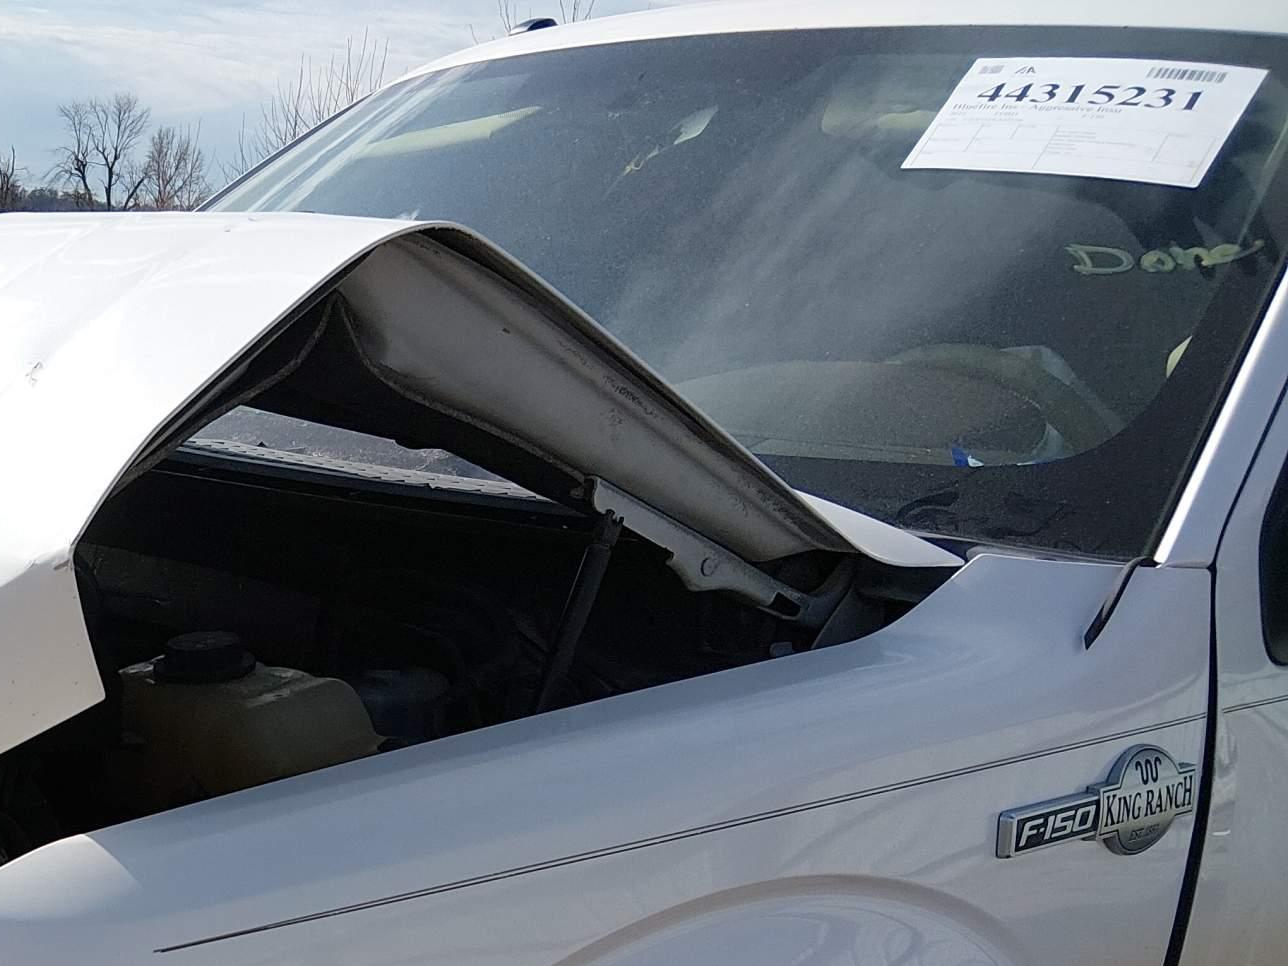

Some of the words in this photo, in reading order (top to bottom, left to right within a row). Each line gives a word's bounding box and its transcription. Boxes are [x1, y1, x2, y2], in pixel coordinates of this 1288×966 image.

[977, 82, 1204, 111] 44315231
[1103, 792, 1142, 828] KING
[1144, 774, 1194, 818] RANCH
[1019, 804, 1097, 847] F-150
